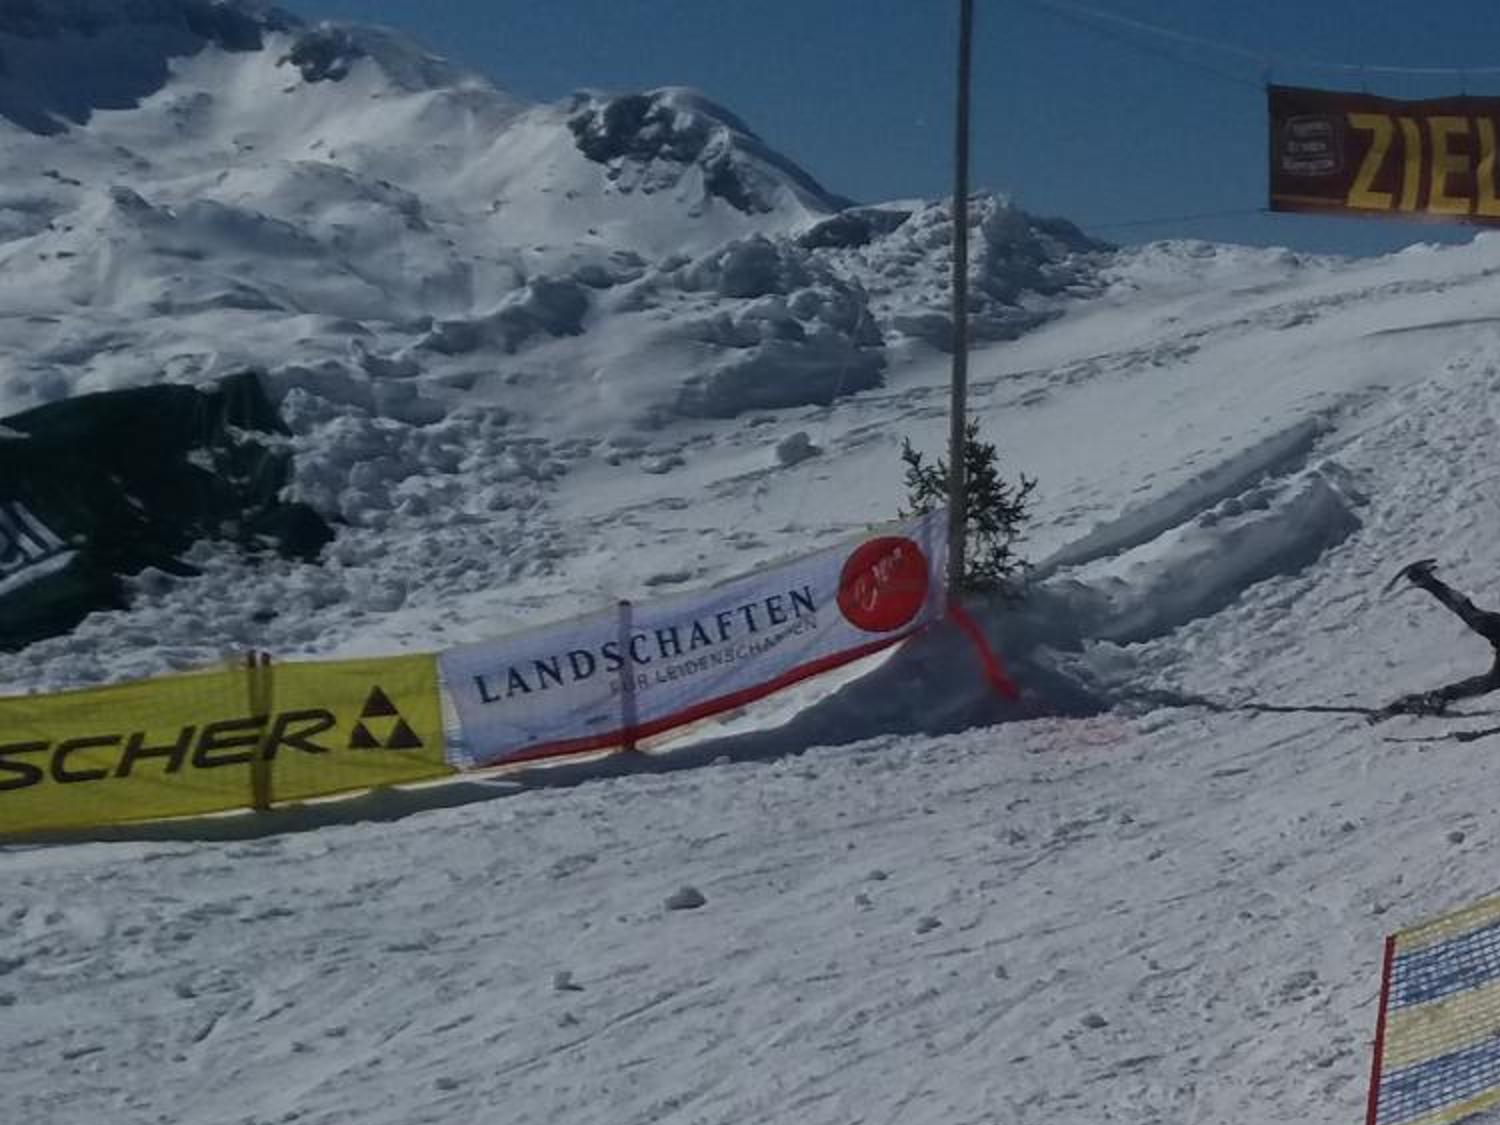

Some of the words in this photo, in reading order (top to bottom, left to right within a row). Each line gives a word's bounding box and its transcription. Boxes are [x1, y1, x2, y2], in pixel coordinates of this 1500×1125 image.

[473, 585, 818, 705] LANDSCHAFTEN
[655, 615, 818, 684] LEIDENSCHAEN
[0, 708, 337, 791] SCHER
